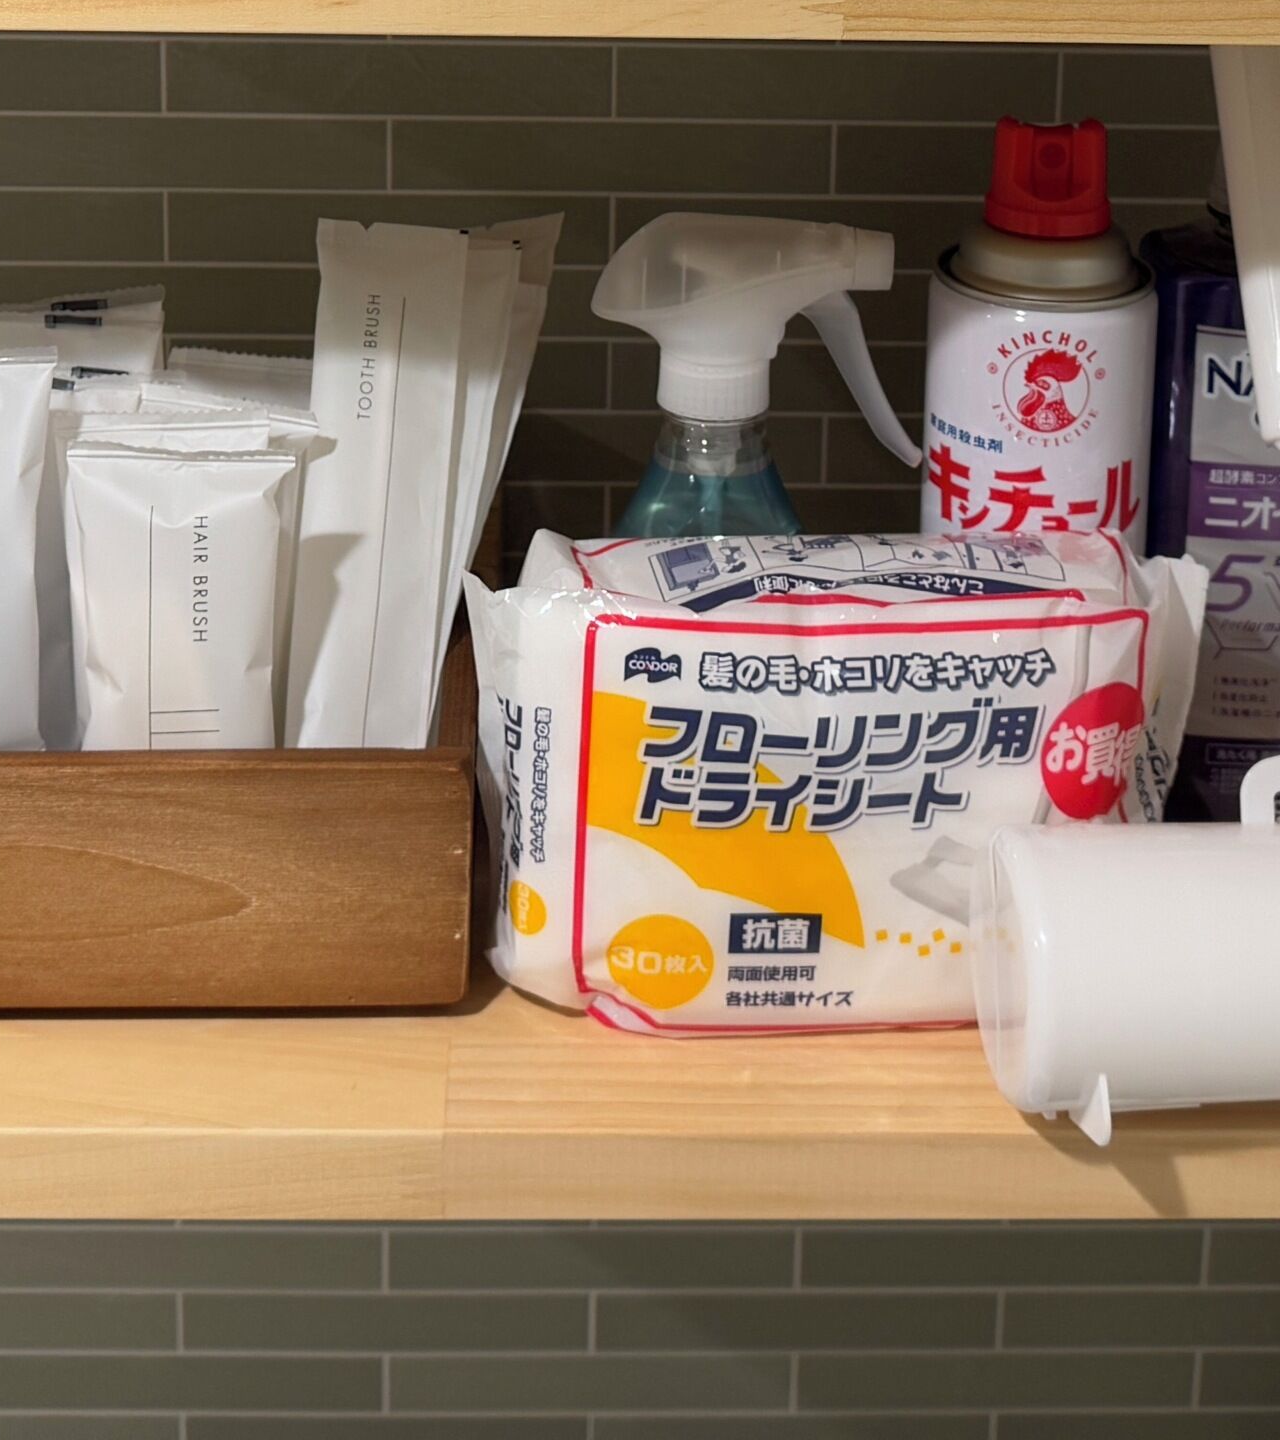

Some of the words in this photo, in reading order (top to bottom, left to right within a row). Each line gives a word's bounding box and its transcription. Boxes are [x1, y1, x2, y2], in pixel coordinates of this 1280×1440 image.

[363, 294, 381, 348] BRUSH
[996, 329, 1098, 363] KINCHOL
[357, 357, 376, 420] TOOTH
[930, 412, 1003, 454] 家庭用殺虫剤
[992, 403, 1098, 448] INSECTICIDE
[192, 515, 209, 563] HAIR
[192, 575, 209, 643] BRUSH
[628, 659, 679, 673] CONDOR
[699, 648, 1056, 695] 髪の毛・ホコリをキャッチ
[641, 696, 1040, 769] フローリング用
[640, 766, 965, 827] ドライシート
[741, 917, 811, 951] 抗菌
[610, 945, 708, 976] 30枚入
[727, 964, 817, 983] 両面使用可
[725, 990, 855, 1008] 各社共通サイズ
